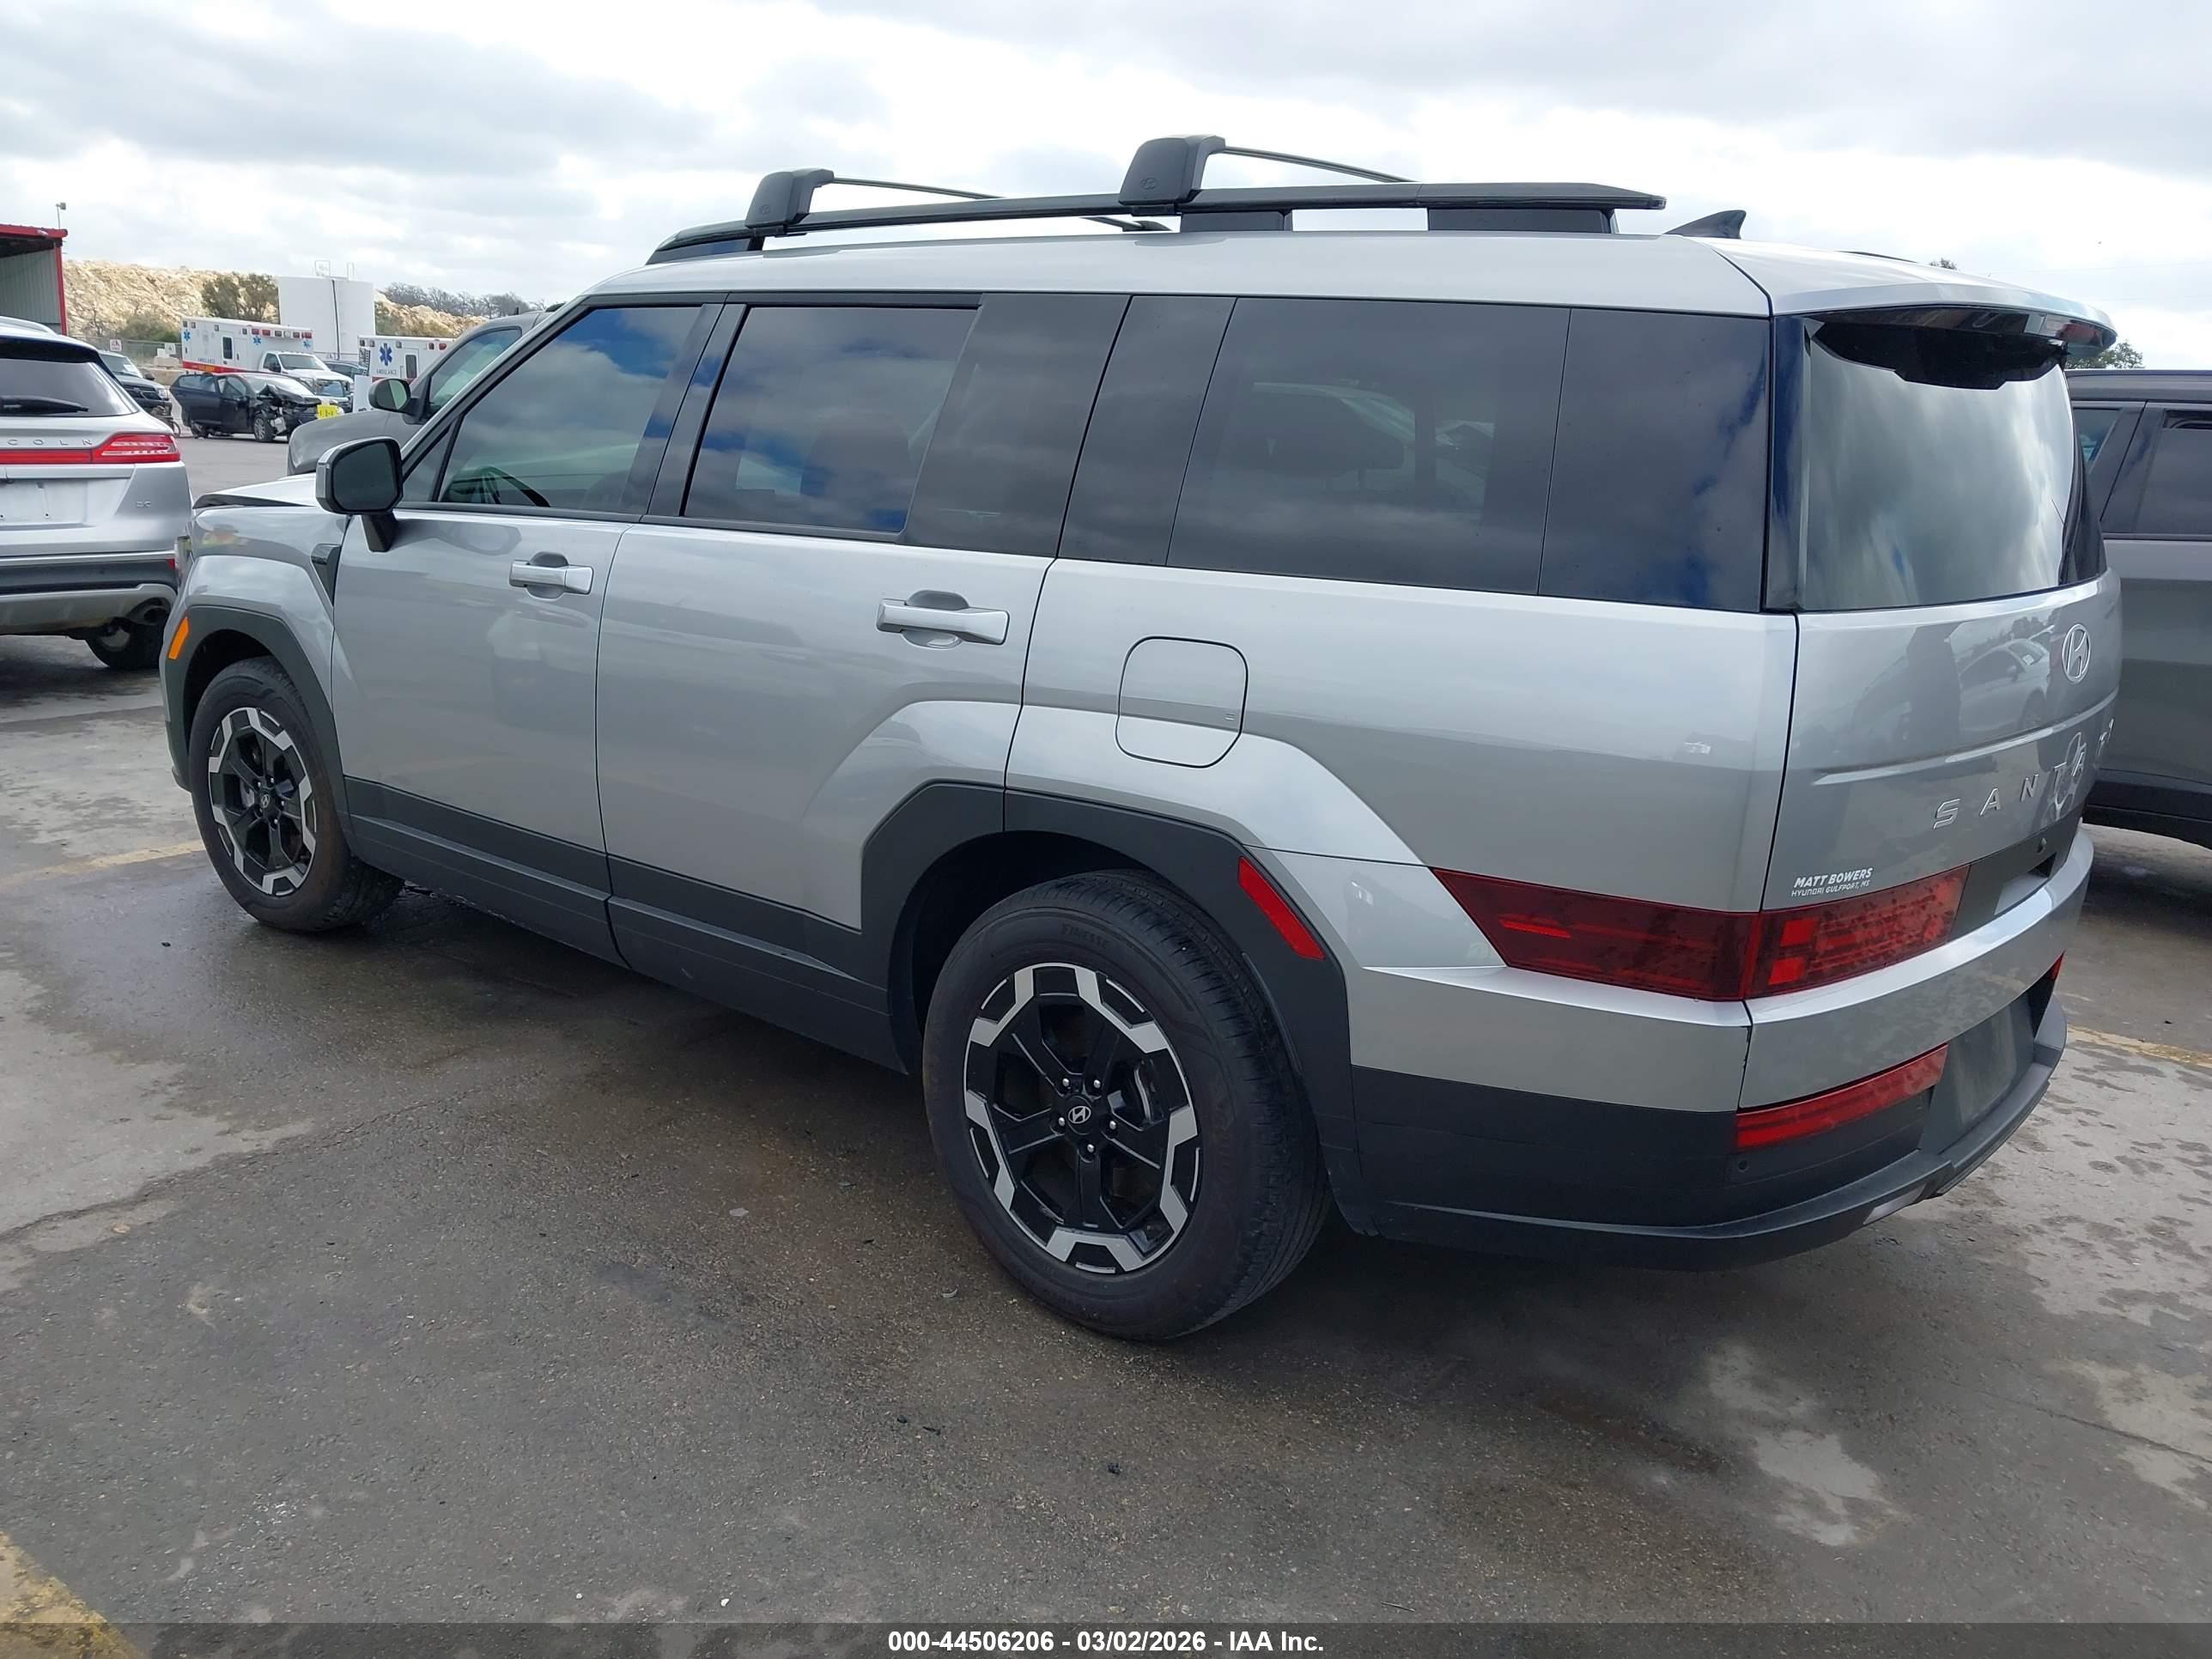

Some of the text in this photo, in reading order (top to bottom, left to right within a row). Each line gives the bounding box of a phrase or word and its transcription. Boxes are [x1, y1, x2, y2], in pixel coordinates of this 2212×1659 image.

[1934, 752, 2086, 830] SANTA
[1793, 867, 1873, 888] MATT BOWERS
[1826, 881, 1859, 894] GULFPORT,
